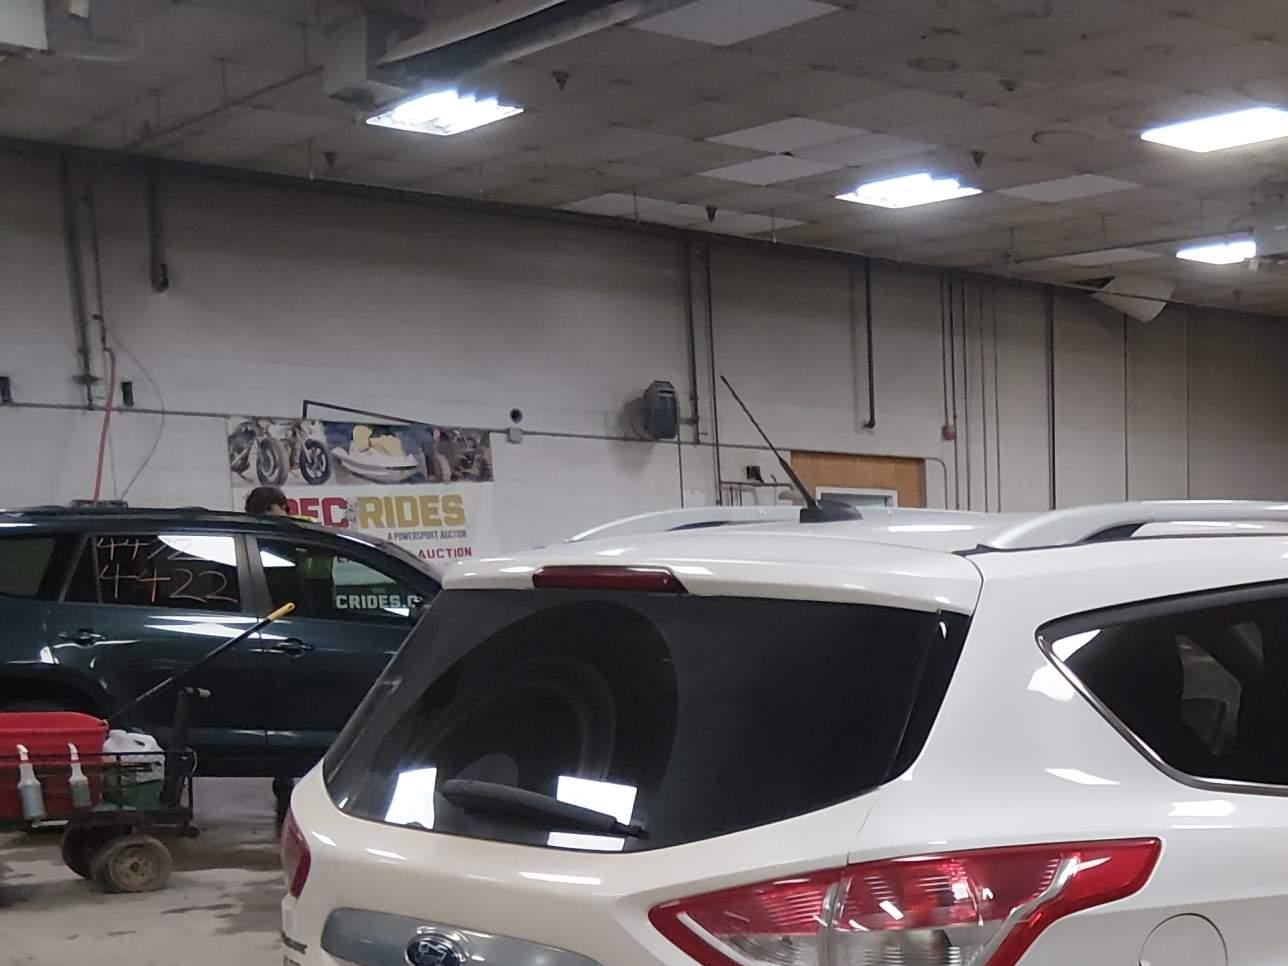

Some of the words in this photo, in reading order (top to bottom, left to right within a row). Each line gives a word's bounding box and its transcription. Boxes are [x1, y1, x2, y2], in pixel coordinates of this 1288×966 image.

[357, 495, 466, 528] RIDES
[394, 531, 438, 541] POWERSPORT
[440, 529, 467, 539] AUCTION
[418, 547, 472, 559] AUCTION
[101, 563, 238, 603] 4422
